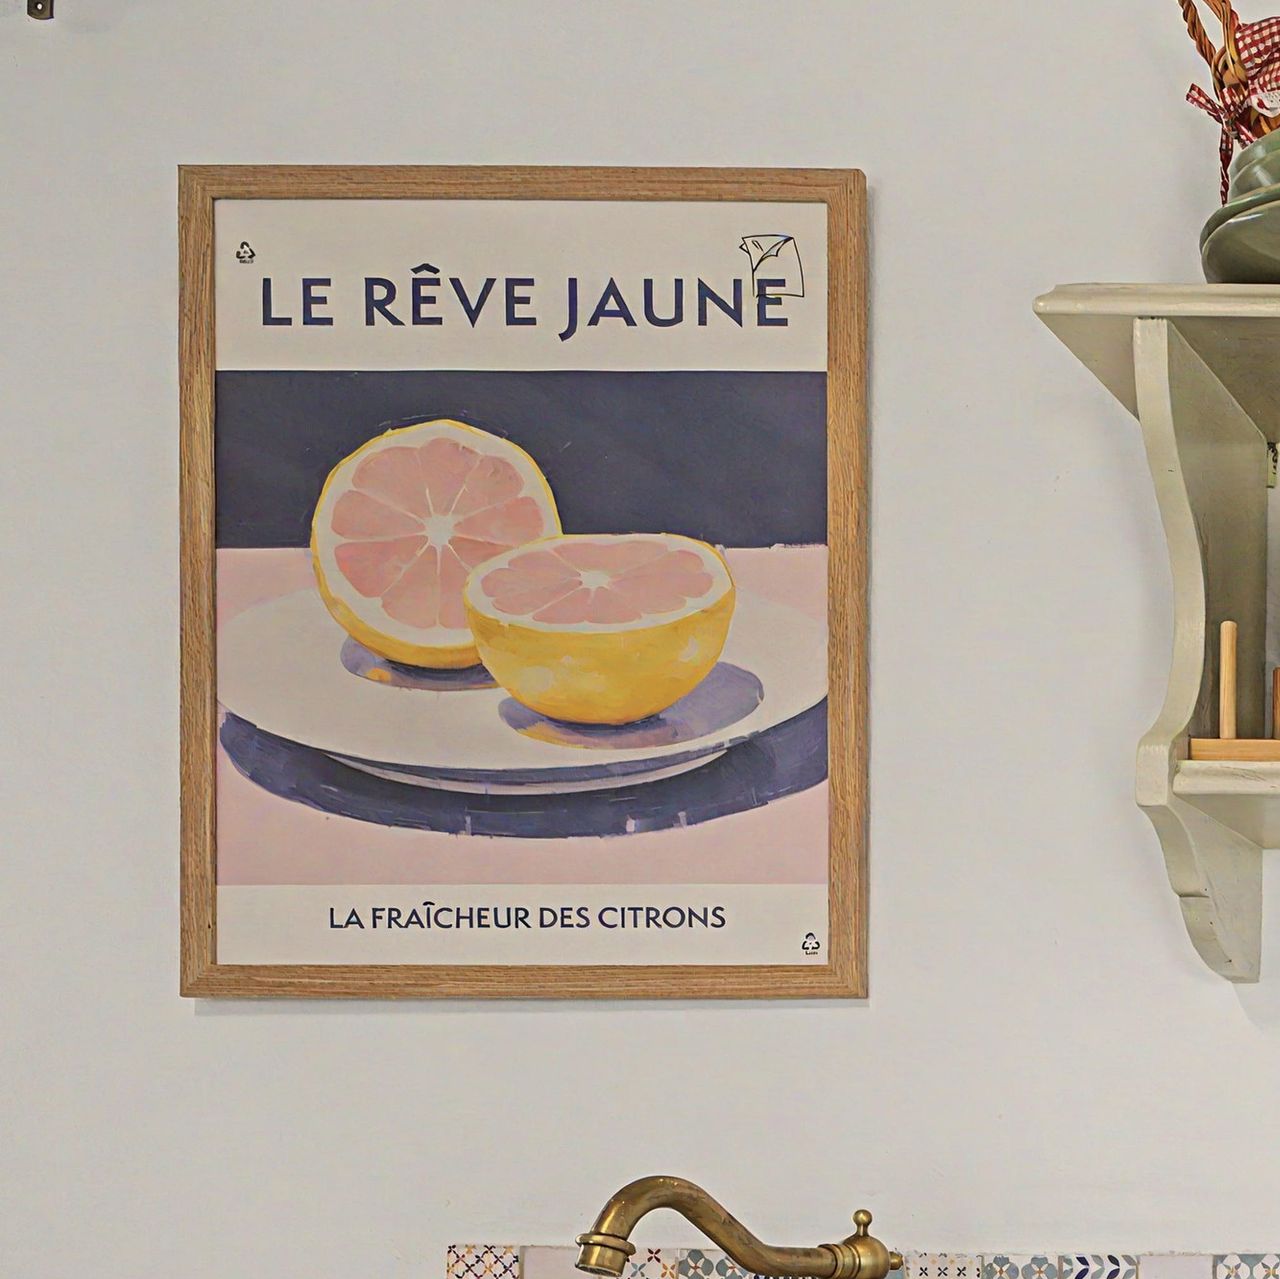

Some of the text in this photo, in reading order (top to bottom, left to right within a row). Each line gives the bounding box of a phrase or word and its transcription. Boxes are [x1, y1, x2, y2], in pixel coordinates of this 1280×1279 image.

[262, 262, 789, 343] LE RÊVE JAUNE
[329, 900, 726, 929] LA FRAÎCHEUR DES CITRONS
